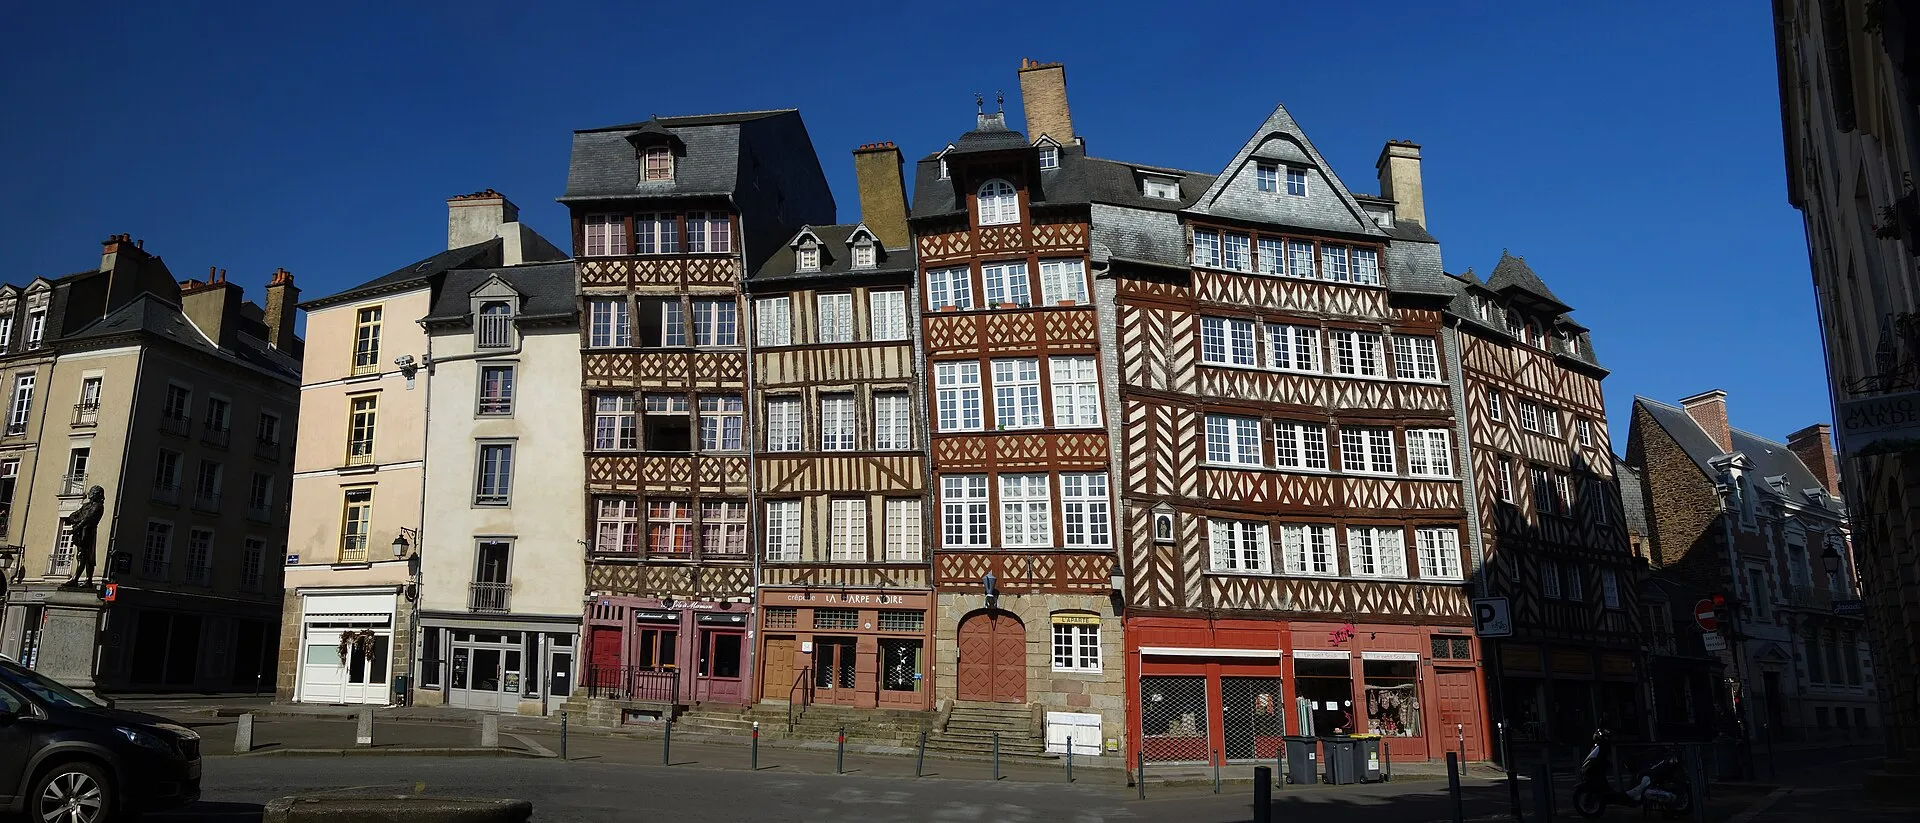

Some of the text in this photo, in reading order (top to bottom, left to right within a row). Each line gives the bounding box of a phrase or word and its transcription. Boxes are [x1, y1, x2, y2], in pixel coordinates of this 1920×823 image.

[787, 594, 816, 602] crêpeie
[826, 594, 837, 604] LA
[1476, 604, 1495, 631] P
